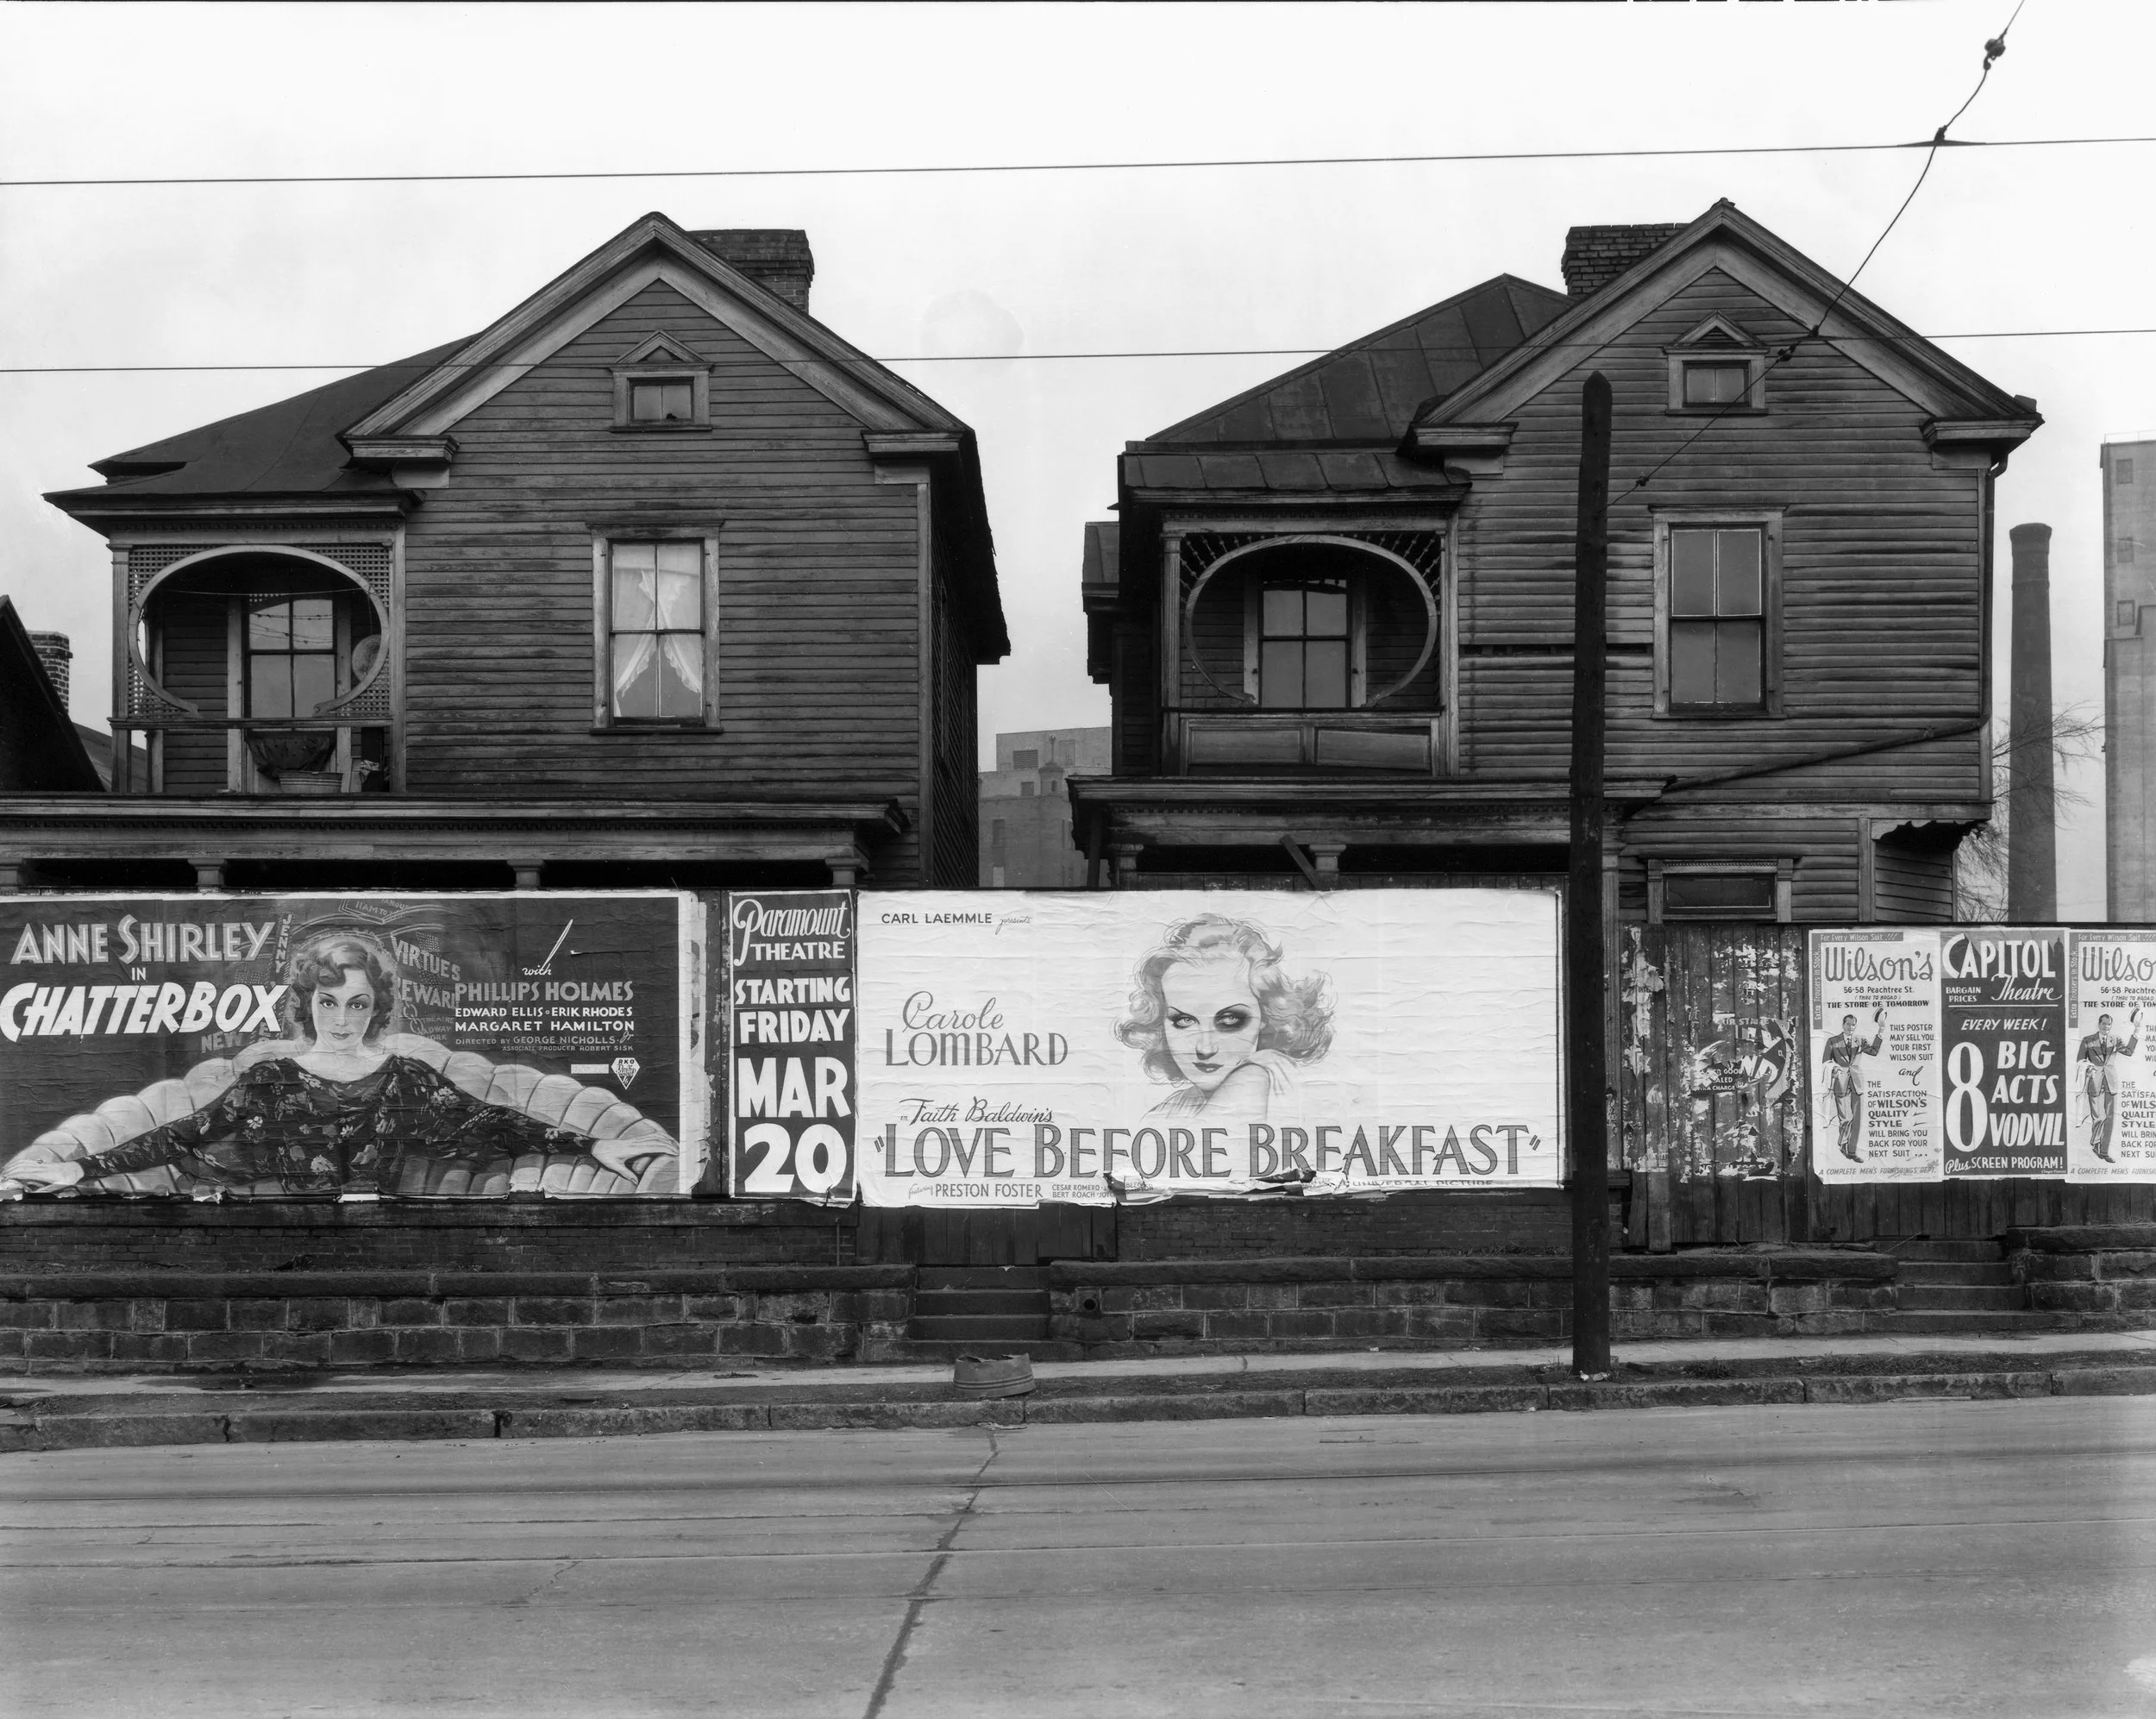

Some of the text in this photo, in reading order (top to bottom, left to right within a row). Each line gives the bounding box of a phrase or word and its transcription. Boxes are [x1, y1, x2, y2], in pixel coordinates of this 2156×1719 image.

[10, 914, 275, 965] ANNE SHIRLEY
[733, 899, 850, 966] Paramount
[881, 913, 1033, 936] CARL LAEMMLE presents
[275, 914, 292, 973] JENNY
[750, 941, 845, 961] THEATRE
[1942, 932, 2056, 978] CAPITOL
[131, 967, 147, 981] IN
[391, 936, 461, 982] VIRTUES
[1825, 947, 1934, 982] Wilson's
[454, 981, 634, 1001] PHILLIPS HOLMES
[735, 976, 850, 1005] STARTING
[1949, 994, 1977, 1003] PRICES
[1990, 973, 2063, 1001] Theatre
[0, 981, 290, 1043] CHATTERBOX
[454, 1007, 633, 1017] EDWARD ELLIS ERIK RHODES
[454, 1021, 542, 1032] MARGARET
[550, 1020, 635, 1032] HAMILTON
[739, 1008, 849, 1044] FRIDAY
[902, 991, 1004, 1032] Carole
[1961, 1019, 2046, 1031] EVERY WEEK!
[885, 1029, 1068, 1066] LOMBARD
[1996, 1040, 2055, 1070] BIG
[738, 1057, 851, 1118] MAR
[1899, 1065, 1923, 1086] and
[1991, 1075, 2059, 1104] ACTS
[899, 1097, 964, 1126] Faith
[964, 1096, 1055, 1124] Baldwin's
[1877, 1098, 1927, 1107] WILSON'S
[1946, 1042, 1988, 1152] 8
[1869, 1110, 1908, 1120] QUALITY
[1990, 1113, 2065, 1146] VODVIL
[743, 1123, 847, 1194] 20
[1034, 1124, 1232, 1179] BEFORE
[1946, 1157, 2063, 1174] Plus SCREEN PROGRAM!
[908, 1183, 1044, 1200] featuring PRESTON FOSTER
